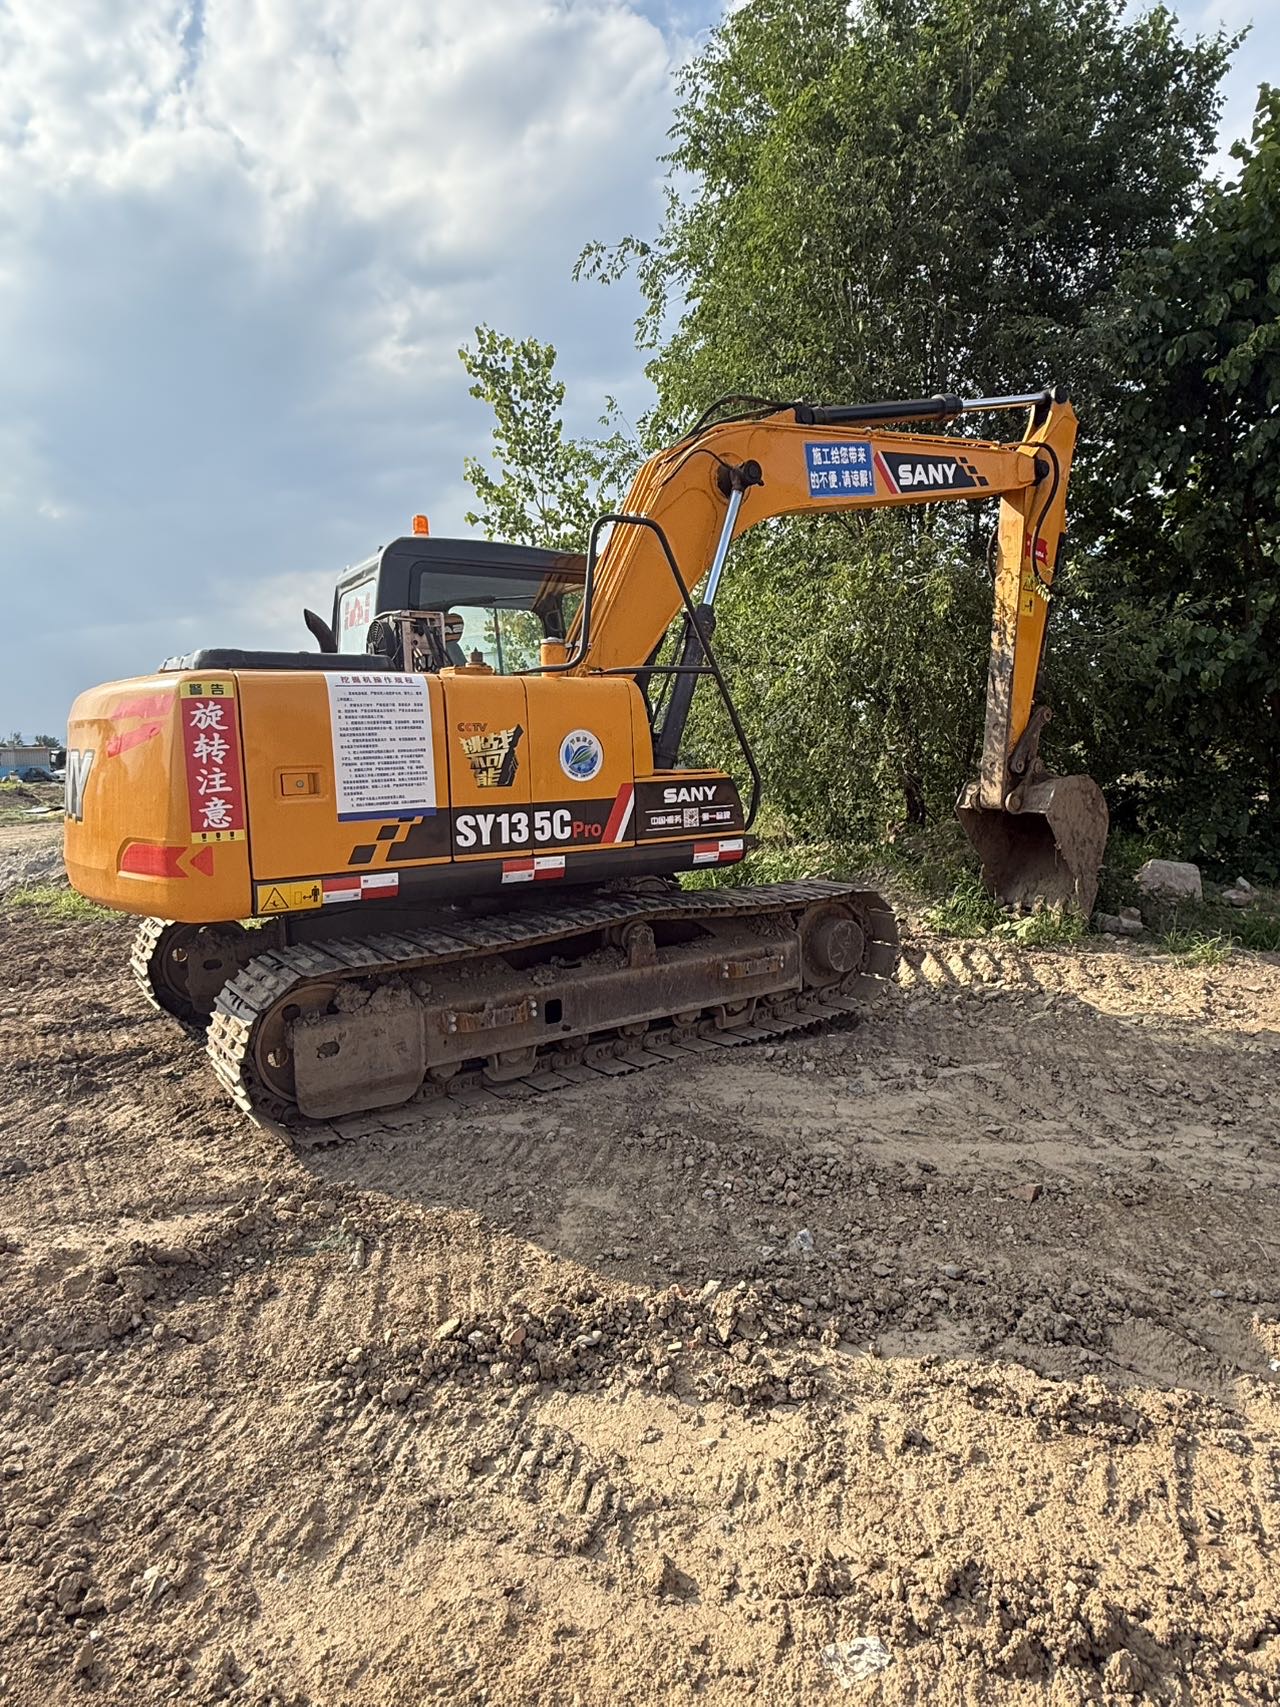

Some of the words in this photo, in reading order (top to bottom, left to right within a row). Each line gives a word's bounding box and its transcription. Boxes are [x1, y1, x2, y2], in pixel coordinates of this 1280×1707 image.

[811, 446, 867, 465] 施工给您带来
[898, 464, 957, 485] SANY
[189, 683, 225, 696] 警告
[457, 722, 488, 732] CCTV
[458, 726, 516, 753] 挑战
[189, 700, 233, 829] 旋转注意
[465, 748, 509, 769] 不可
[475, 767, 502, 787] 能
[663, 786, 717, 804] SANY
[573, 821, 602, 838] Pro
